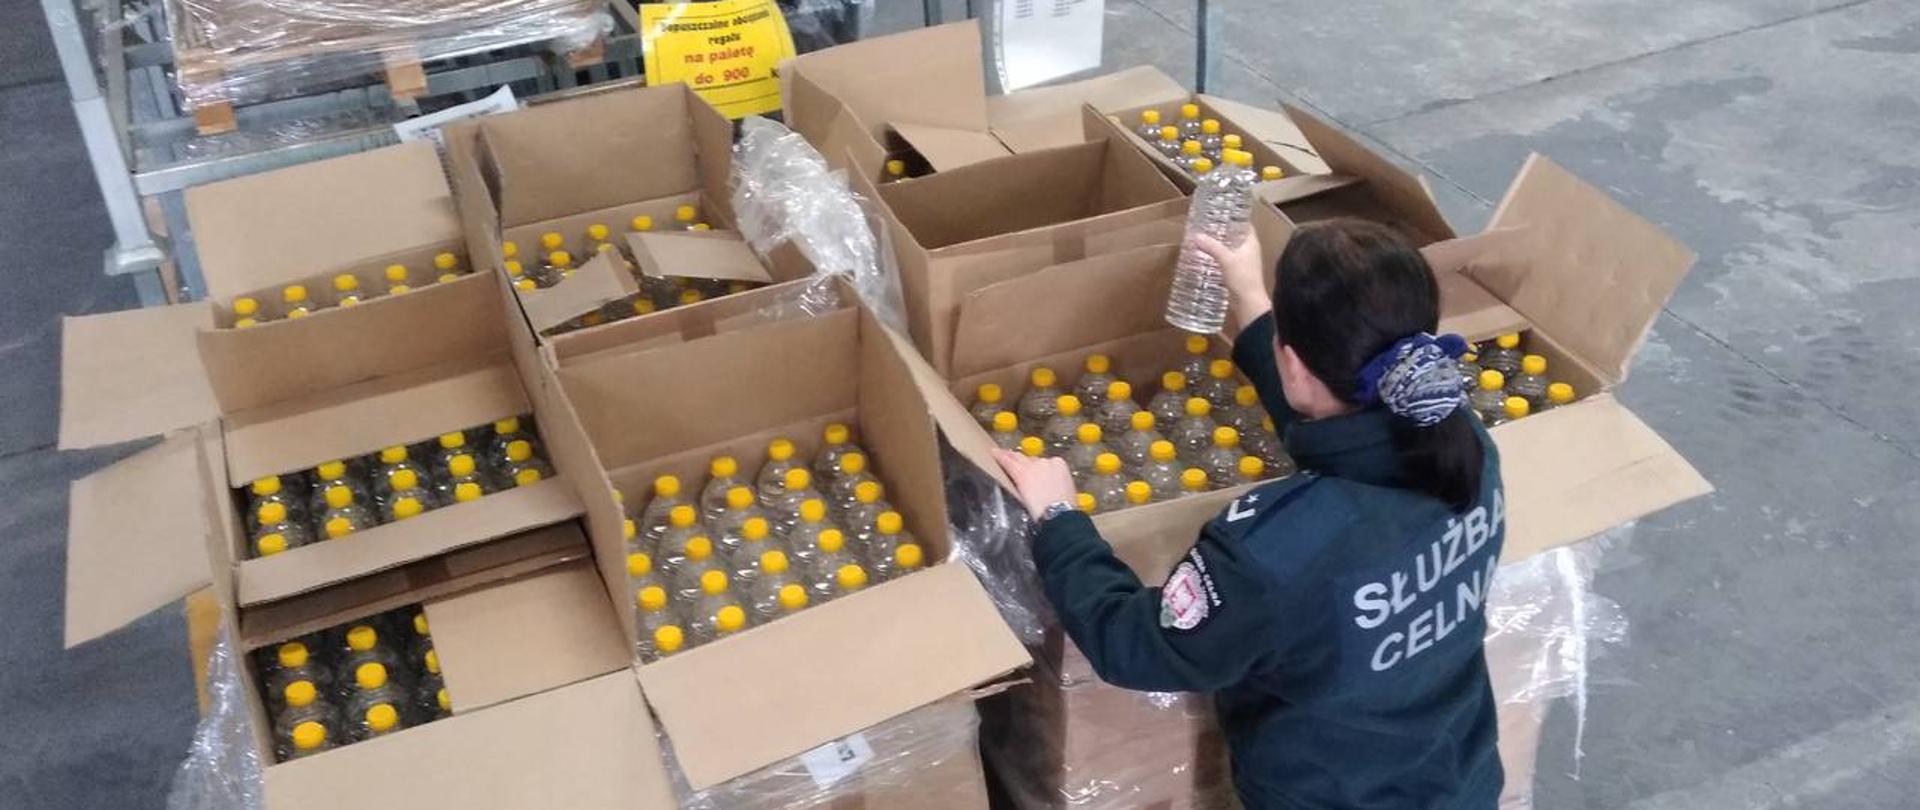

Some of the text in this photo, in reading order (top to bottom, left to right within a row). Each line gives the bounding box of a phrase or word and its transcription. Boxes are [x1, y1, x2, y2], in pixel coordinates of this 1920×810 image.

[684, 53, 704, 63] na
[694, 72, 714, 85] do
[723, 67, 750, 82] 900
